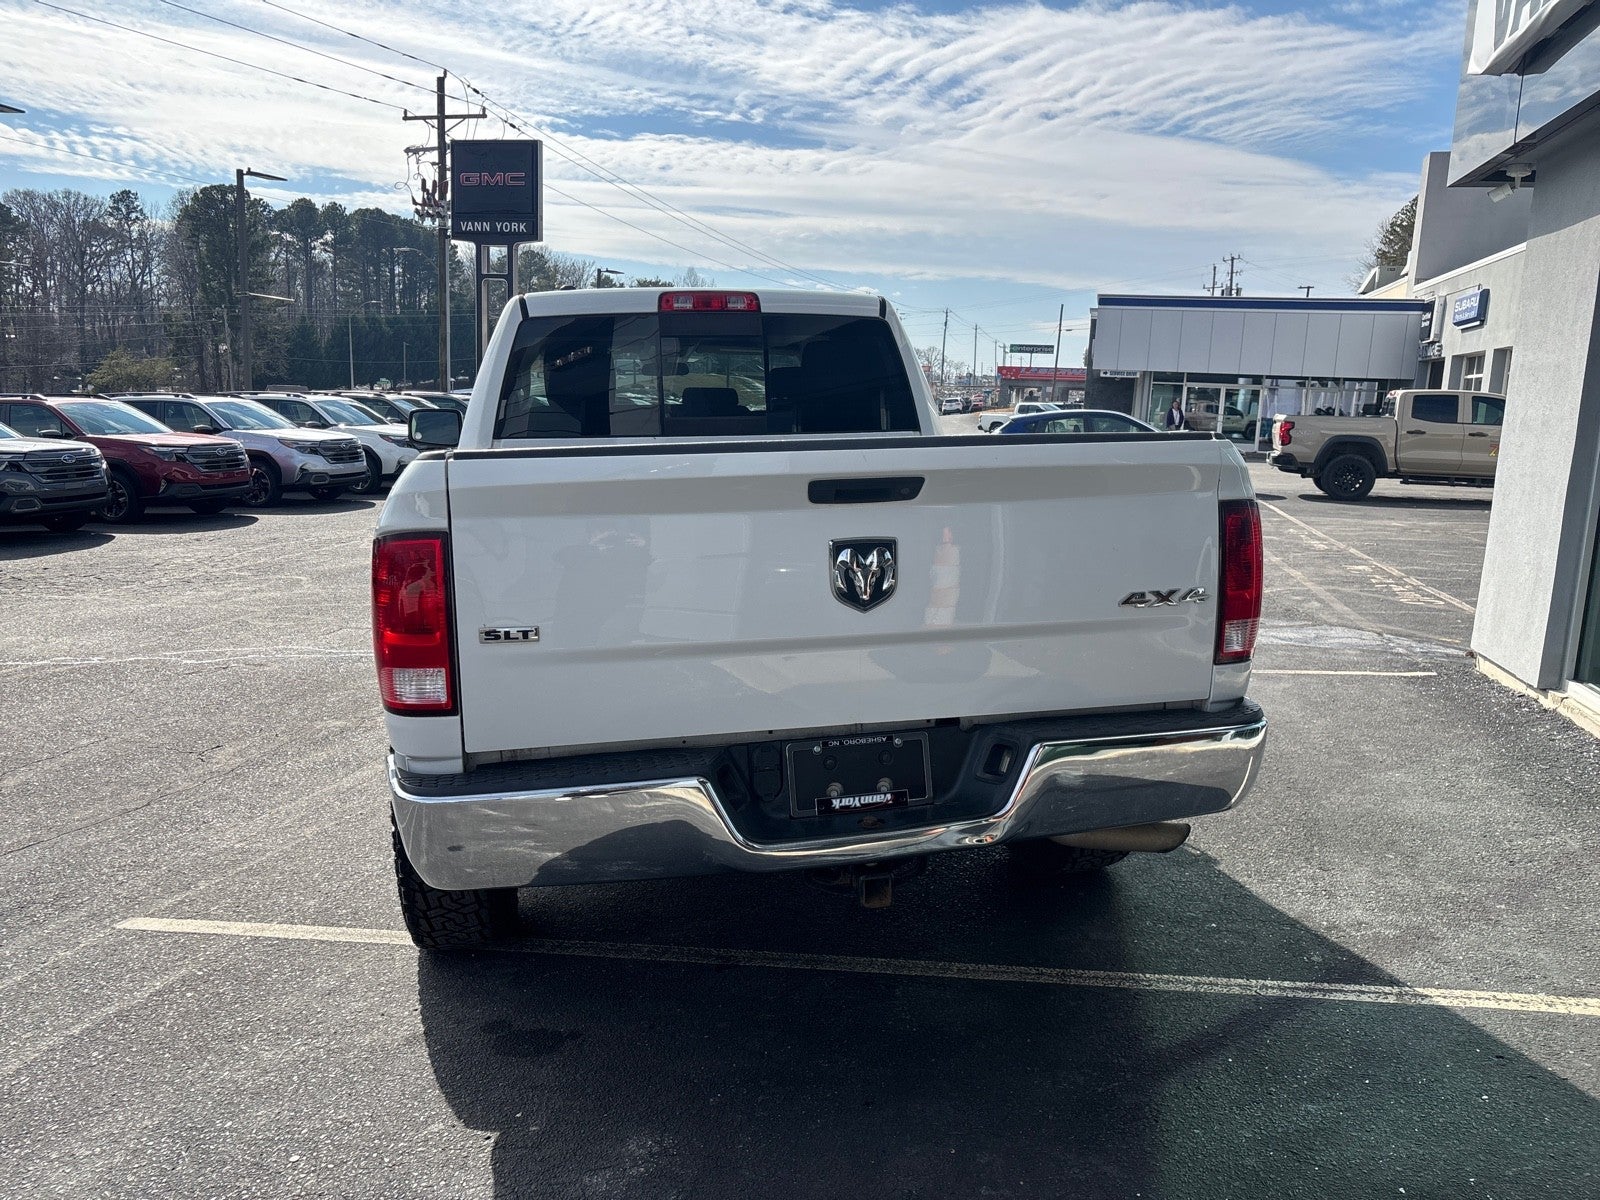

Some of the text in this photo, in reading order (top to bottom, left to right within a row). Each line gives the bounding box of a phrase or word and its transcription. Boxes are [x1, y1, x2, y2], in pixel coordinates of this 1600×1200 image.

[460, 172, 525, 186] GMC
[460, 221, 527, 233] VANN YORK
[1455, 296, 1479, 312] SUBARU
[483, 627, 535, 641] SLT
[842, 736, 887, 746] ASHEBORO,
[831, 793, 893, 809] VannYork
